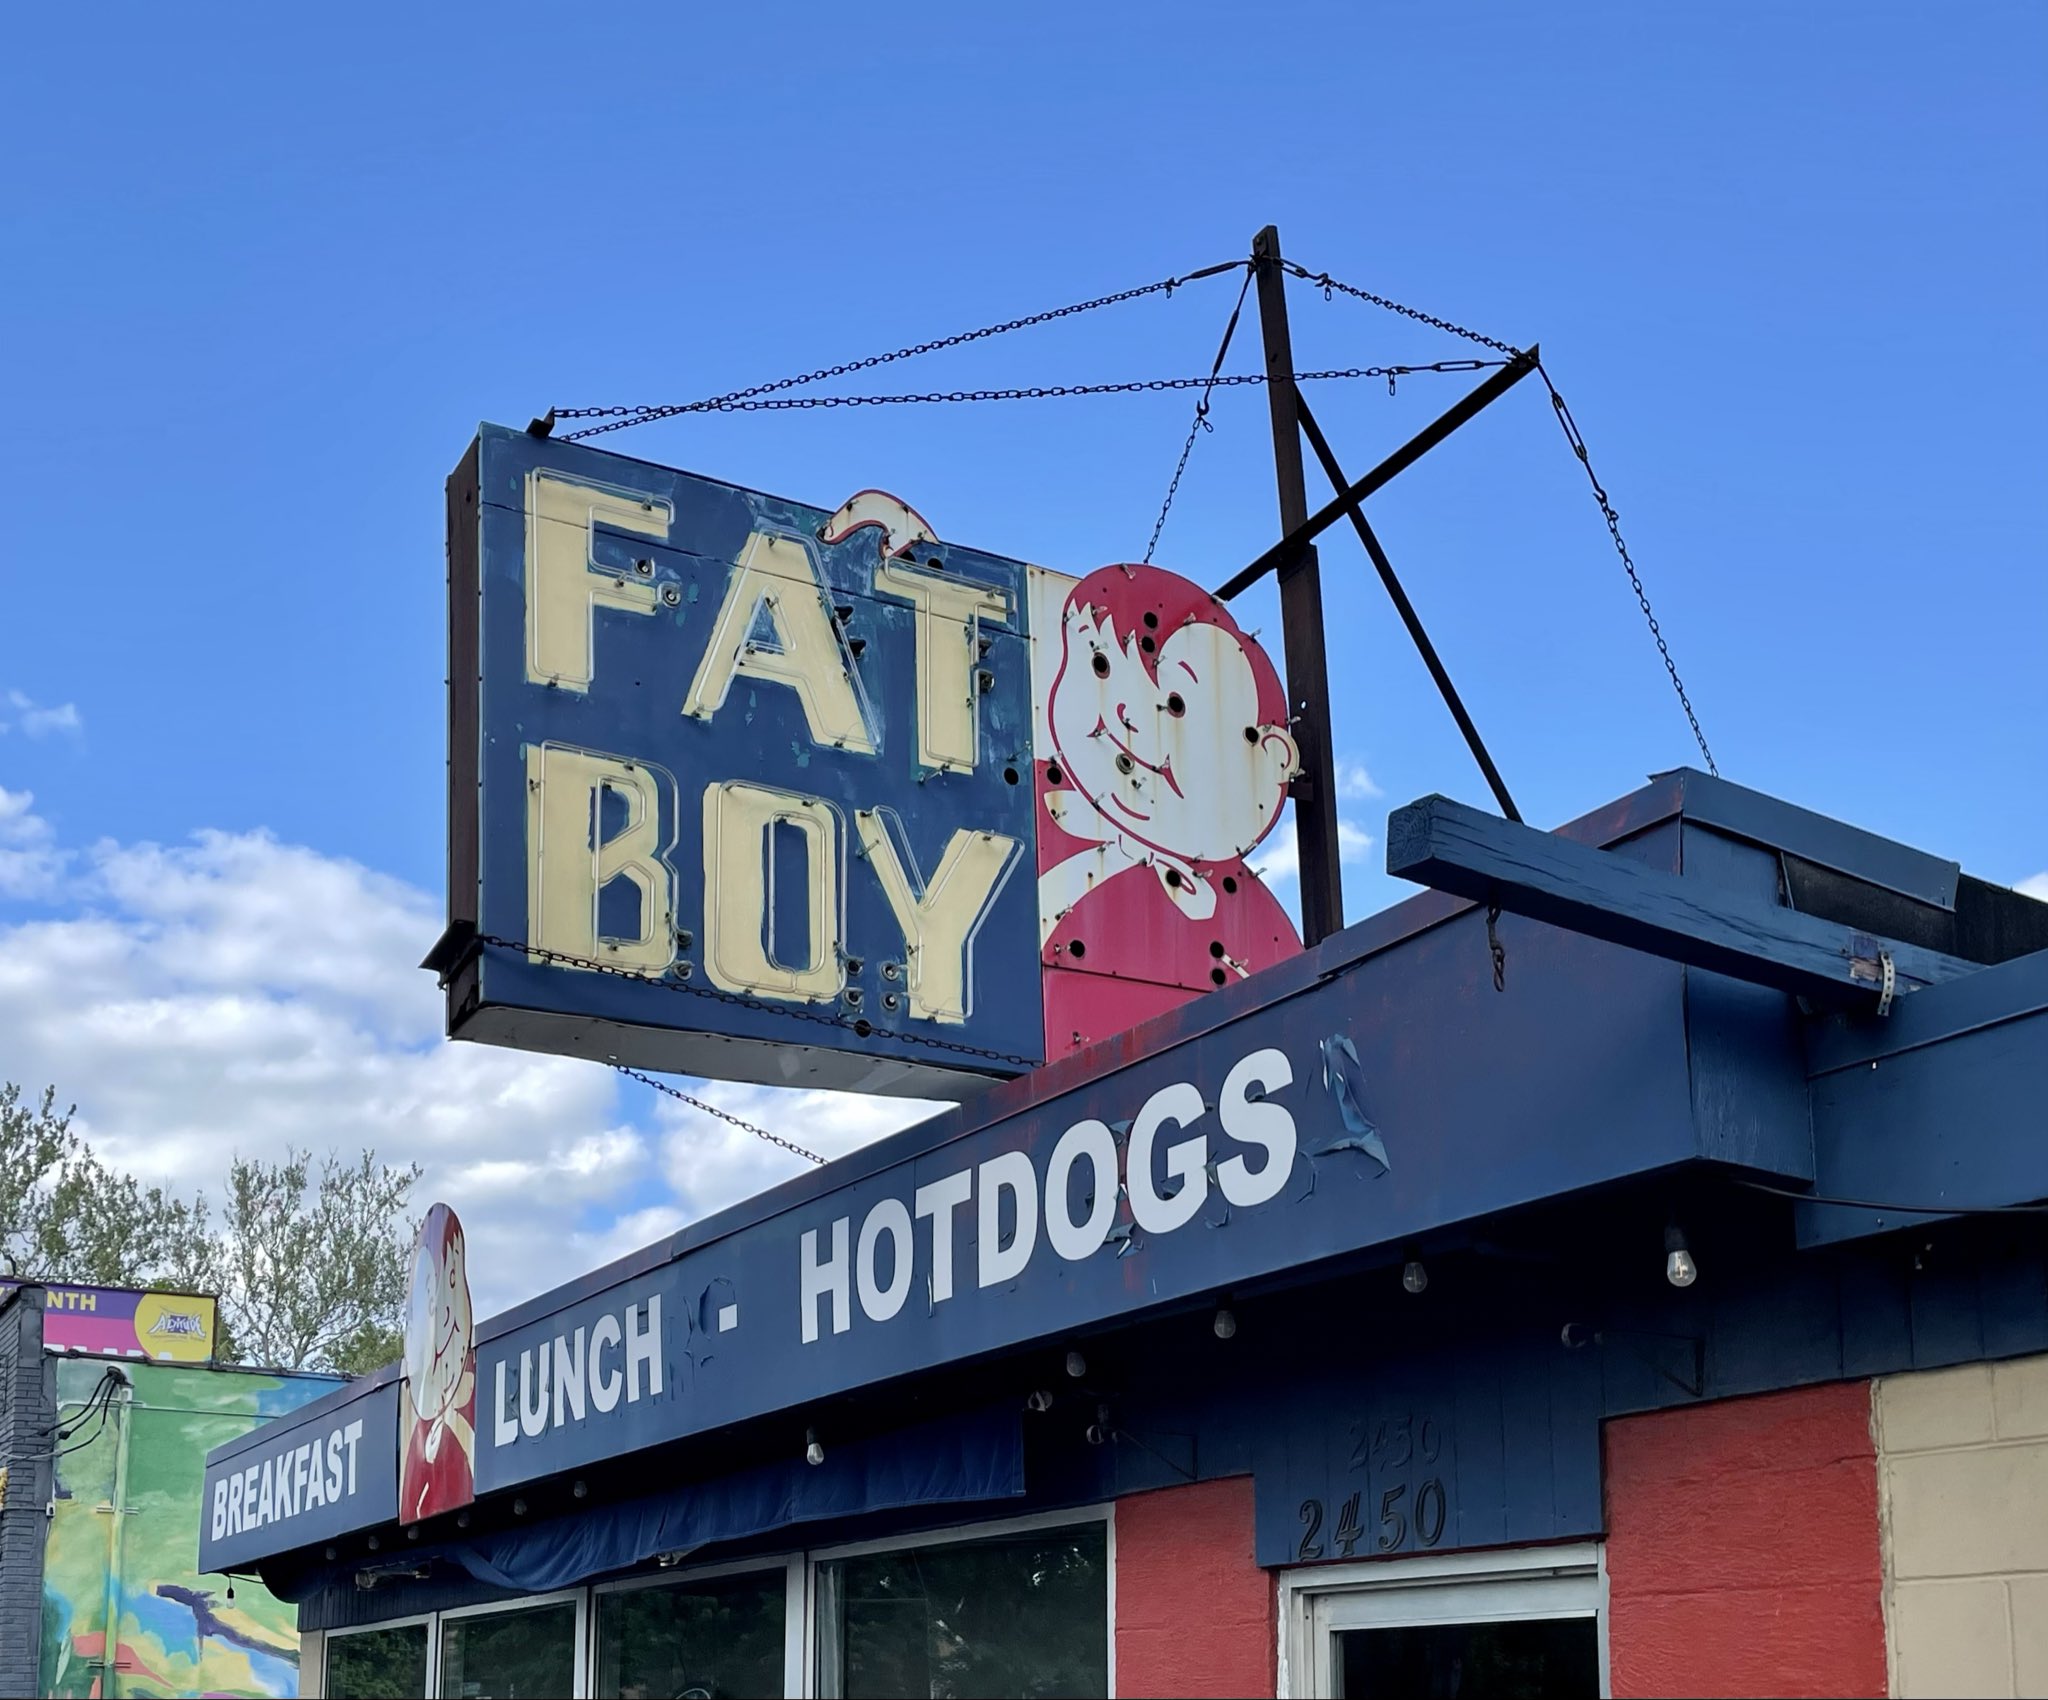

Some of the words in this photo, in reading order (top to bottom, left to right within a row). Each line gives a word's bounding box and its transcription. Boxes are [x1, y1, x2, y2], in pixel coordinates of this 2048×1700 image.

[524, 466, 1017, 776] FAT
[524, 739, 1026, 1025] BOY
[46, 1290, 97, 1312] NTH
[493, 1293, 664, 1448] LUNCH
[800, 1048, 1298, 1345] HOTDOGS
[210, 1418, 364, 1542] BREAKFAST
[1298, 1476, 1447, 1562] 2450
